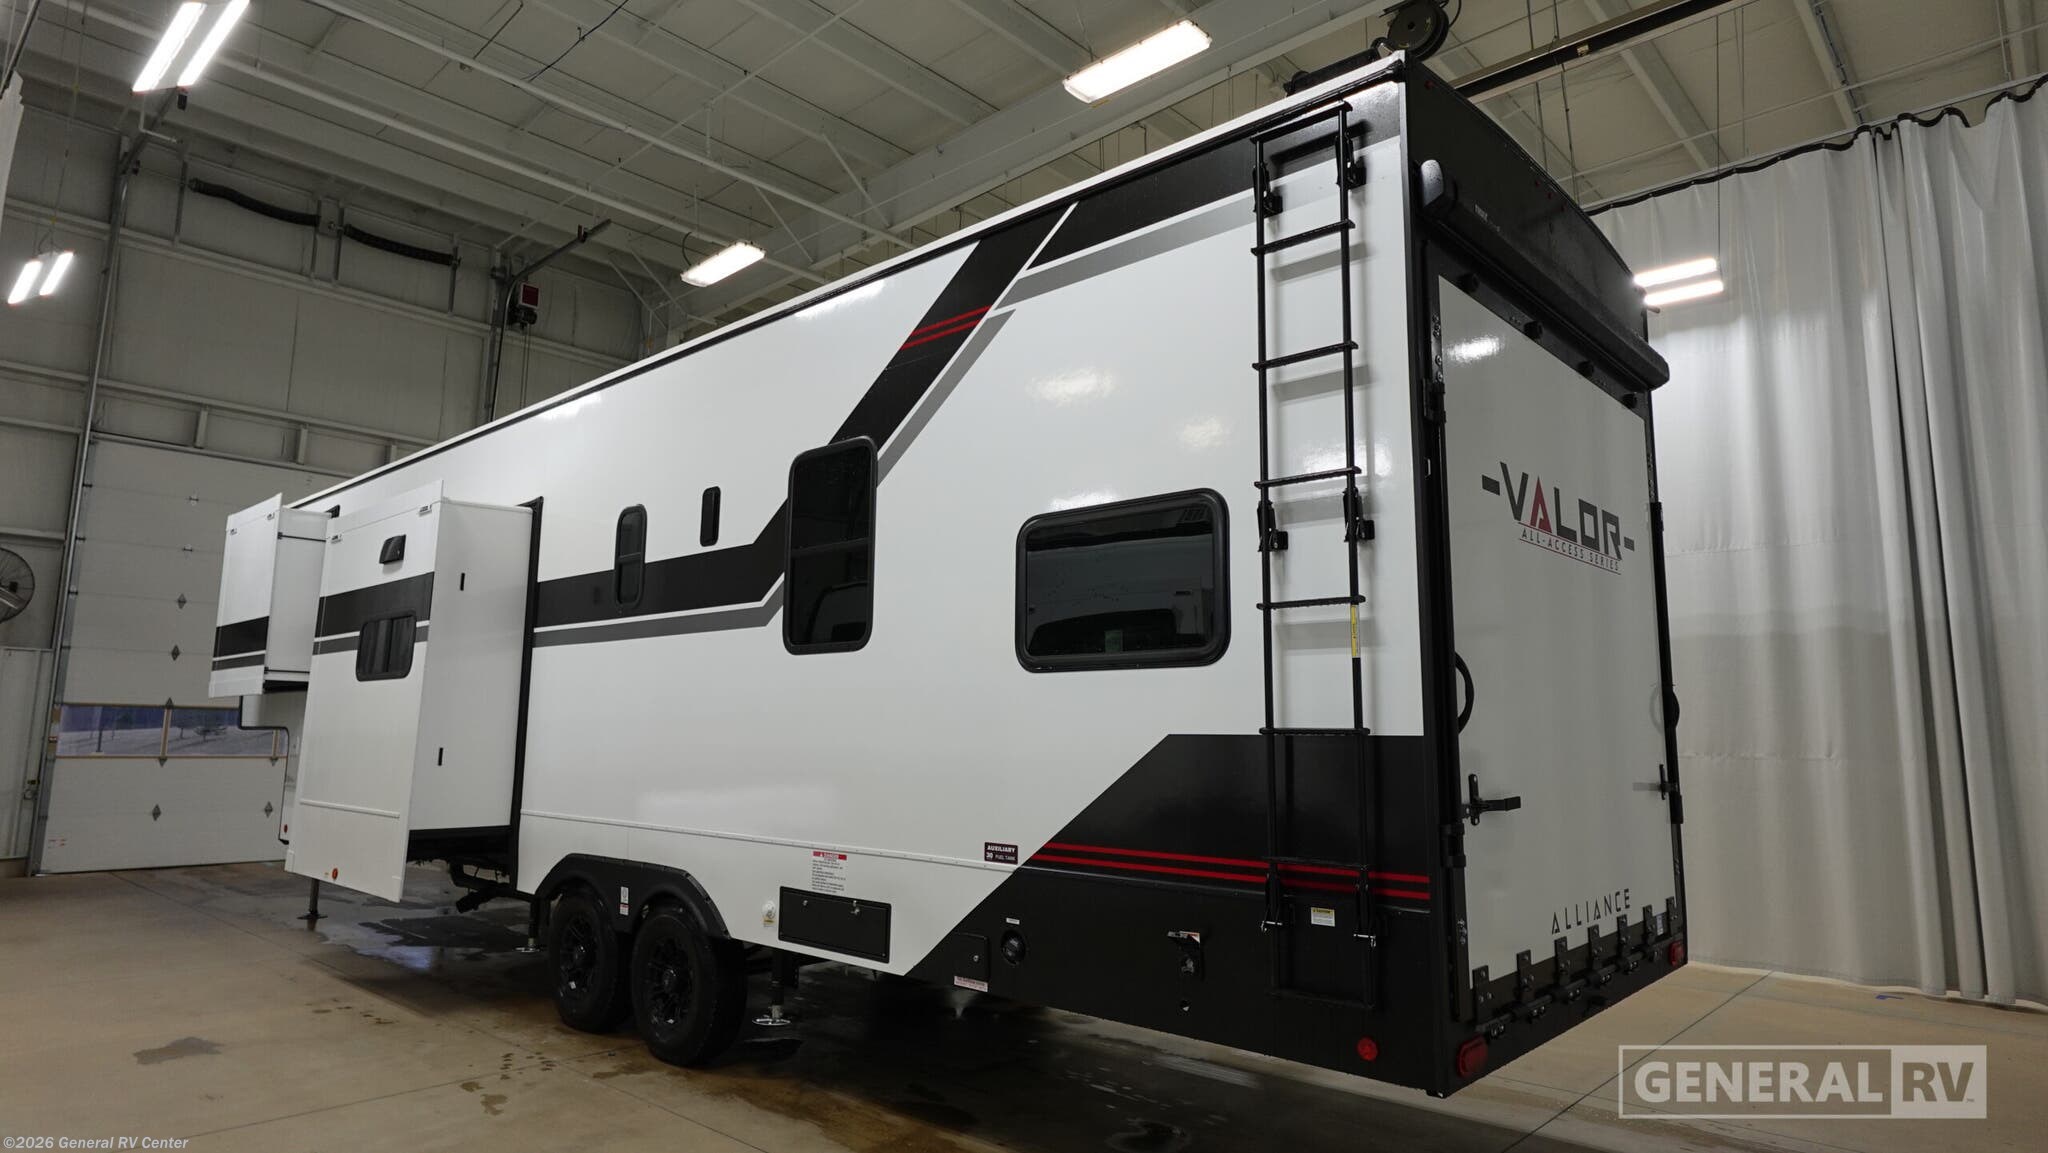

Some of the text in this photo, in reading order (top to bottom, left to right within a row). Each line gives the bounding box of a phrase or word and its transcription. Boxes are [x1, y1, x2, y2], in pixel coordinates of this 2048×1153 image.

[1500, 461, 1622, 560] VALOR
[1522, 528, 1619, 571] ALL-ACCESS SERIES
[1551, 888, 1630, 935] ALLIANCE
